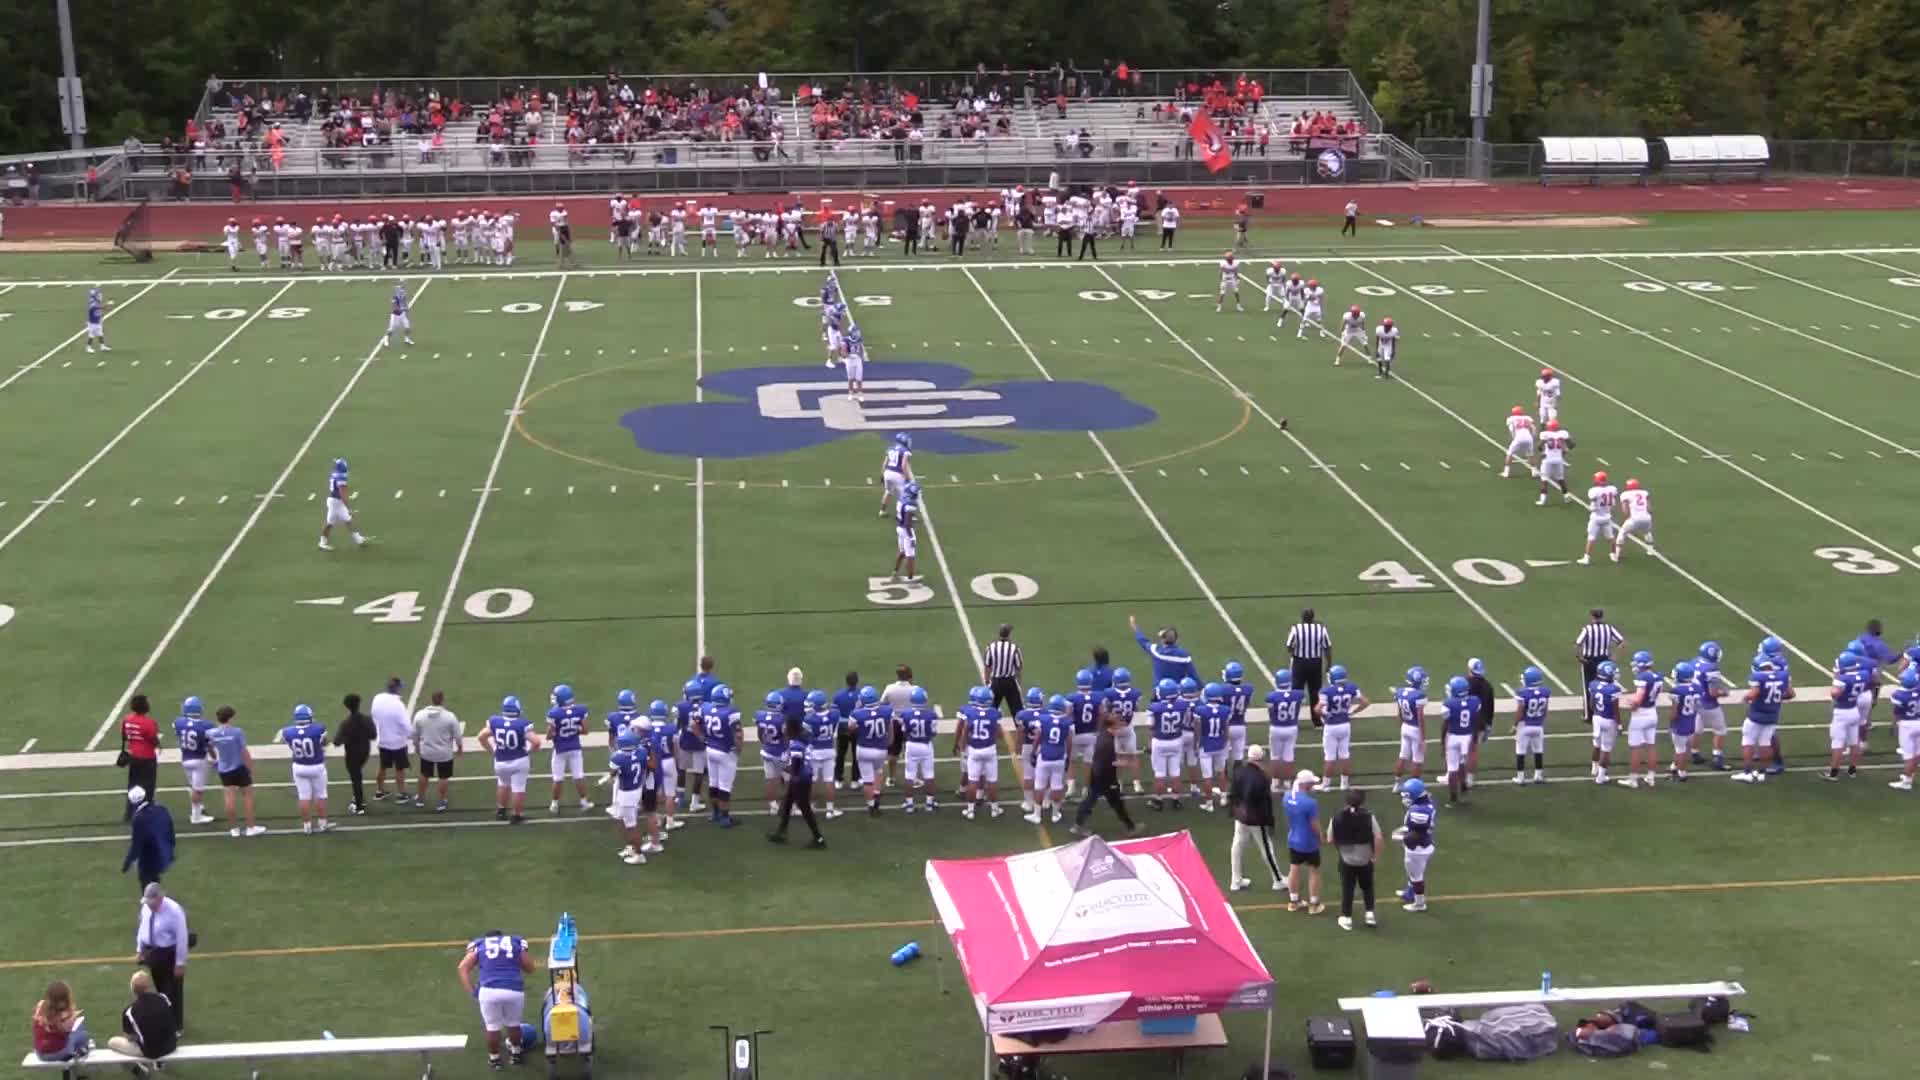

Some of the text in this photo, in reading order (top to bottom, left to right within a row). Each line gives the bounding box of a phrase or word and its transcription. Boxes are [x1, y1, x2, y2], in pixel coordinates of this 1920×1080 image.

[1635, 493, 1645, 506] 2
[1813, 545, 1920, 574] 3
[1358, 558, 1526, 589] 40
[866, 573, 1039, 604] 50
[353, 587, 535, 622] 40
[1594, 693, 1605, 712] 3
[1764, 681, 1784, 703] 75
[1081, 703, 1094, 723] 6
[1277, 701, 1297, 721] 64
[1527, 698, 1547, 717] 82
[559, 716, 581, 737] 25
[703, 715, 724, 738] 72
[864, 718, 886, 739] 70
[909, 719, 926, 738] 31
[972, 719, 990, 740] 15
[1161, 711, 1181, 733] 62
[1208, 717, 1221, 737] 11
[495, 729, 518, 750] 50
[1049, 727, 1061, 744] 9
[631, 763, 641, 785] 7
[484, 936, 514, 959] 54
